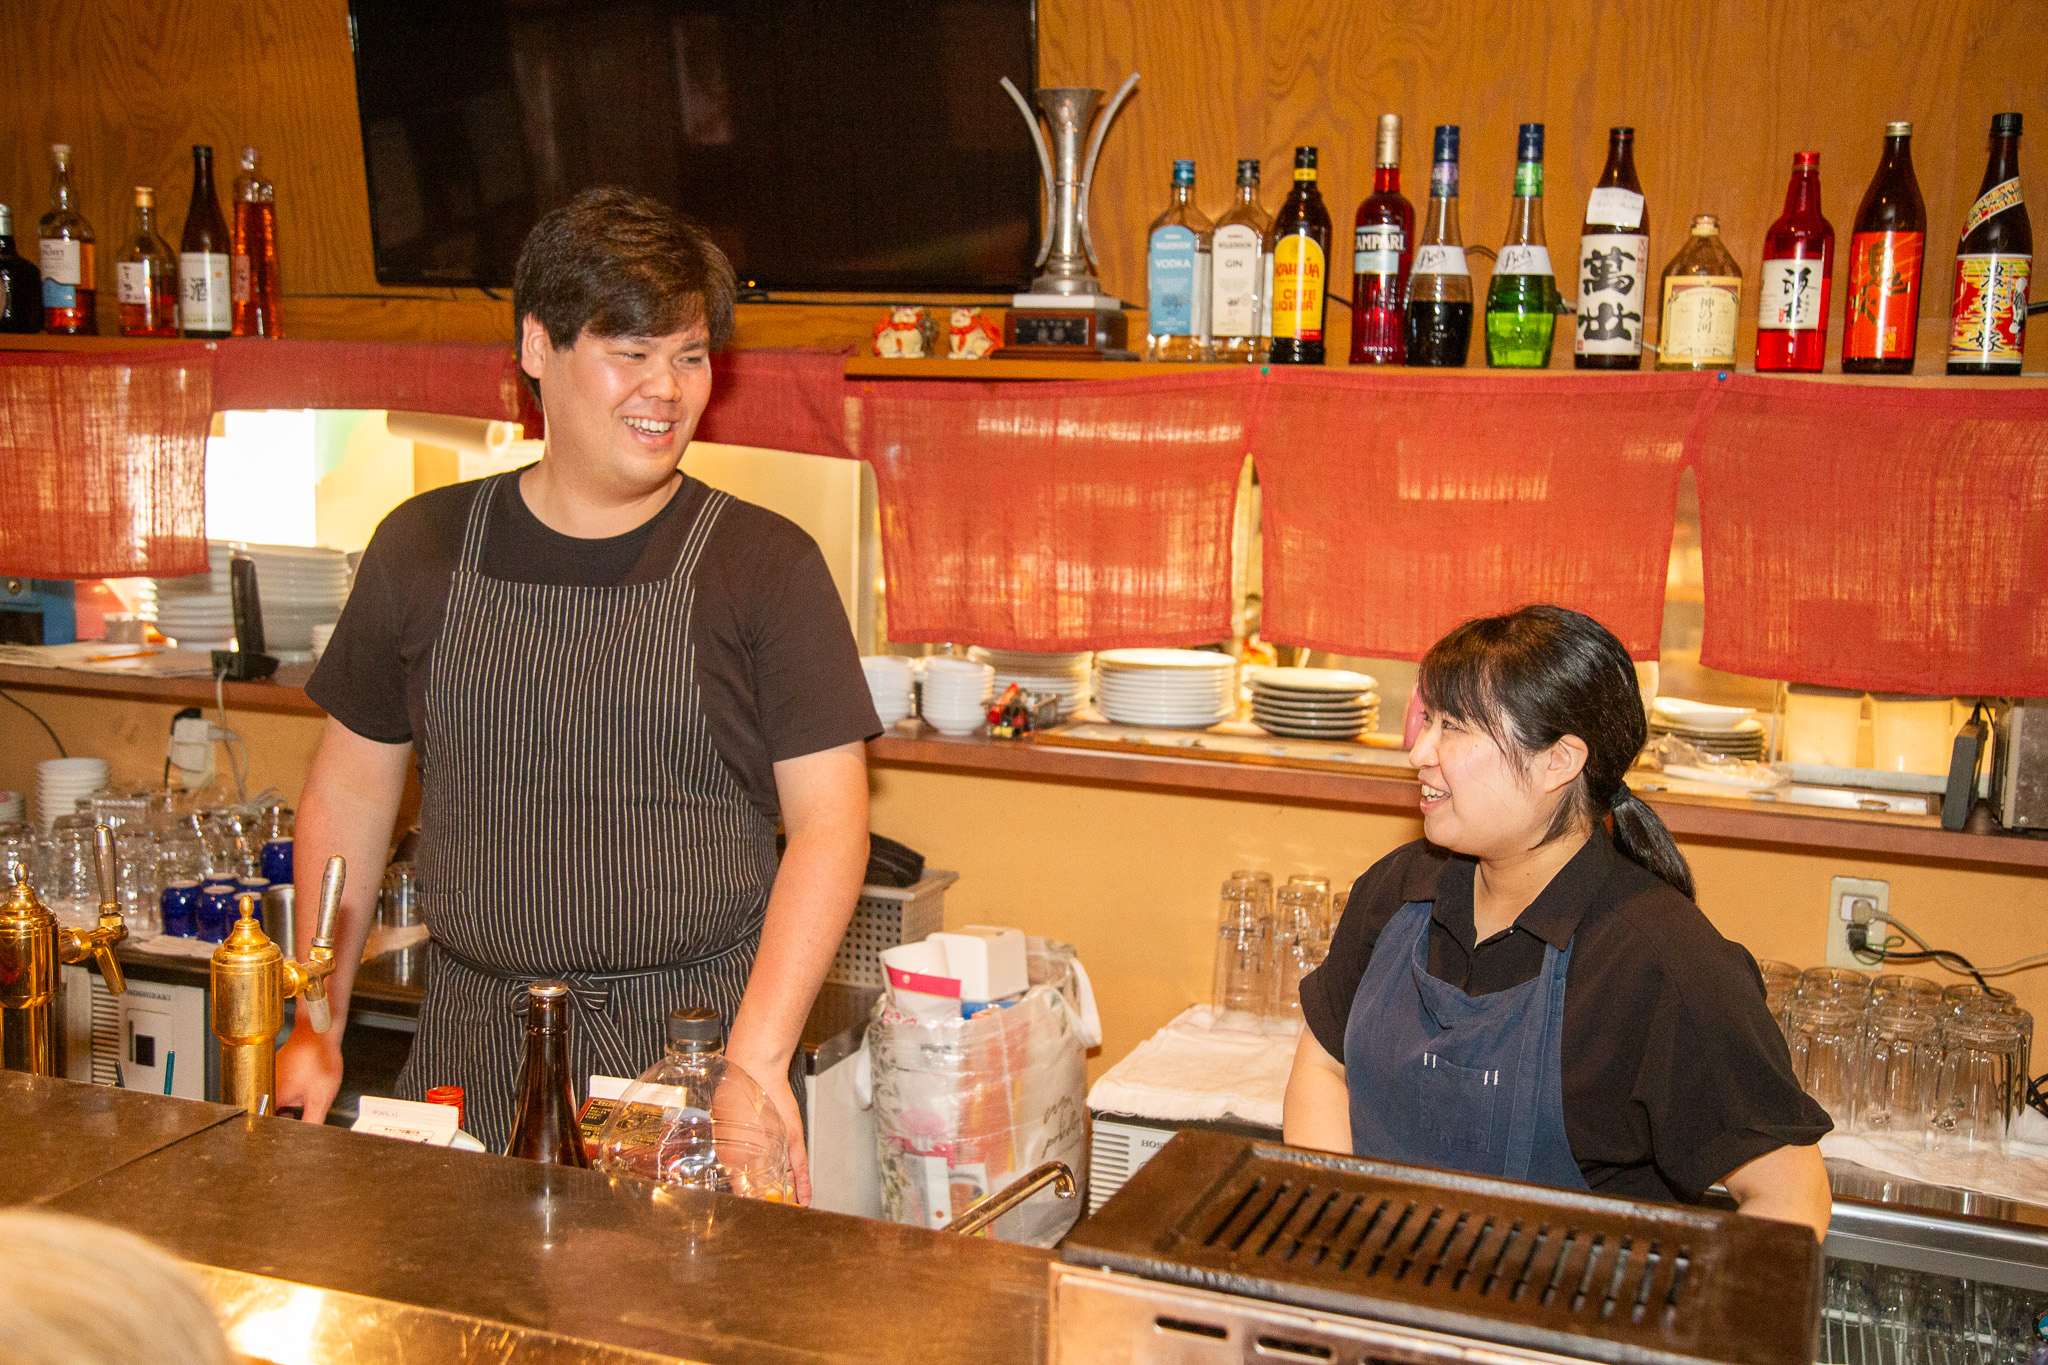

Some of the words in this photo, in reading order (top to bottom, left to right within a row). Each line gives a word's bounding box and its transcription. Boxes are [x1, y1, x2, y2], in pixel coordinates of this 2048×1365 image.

[1355, 233, 1405, 251] AMPARI
[1155, 259, 1191, 269] VODKA
[1225, 259, 1243, 268] GIN
[1697, 297, 1714, 334] 神の河
[1141, 1139, 1166, 1149] HOS
